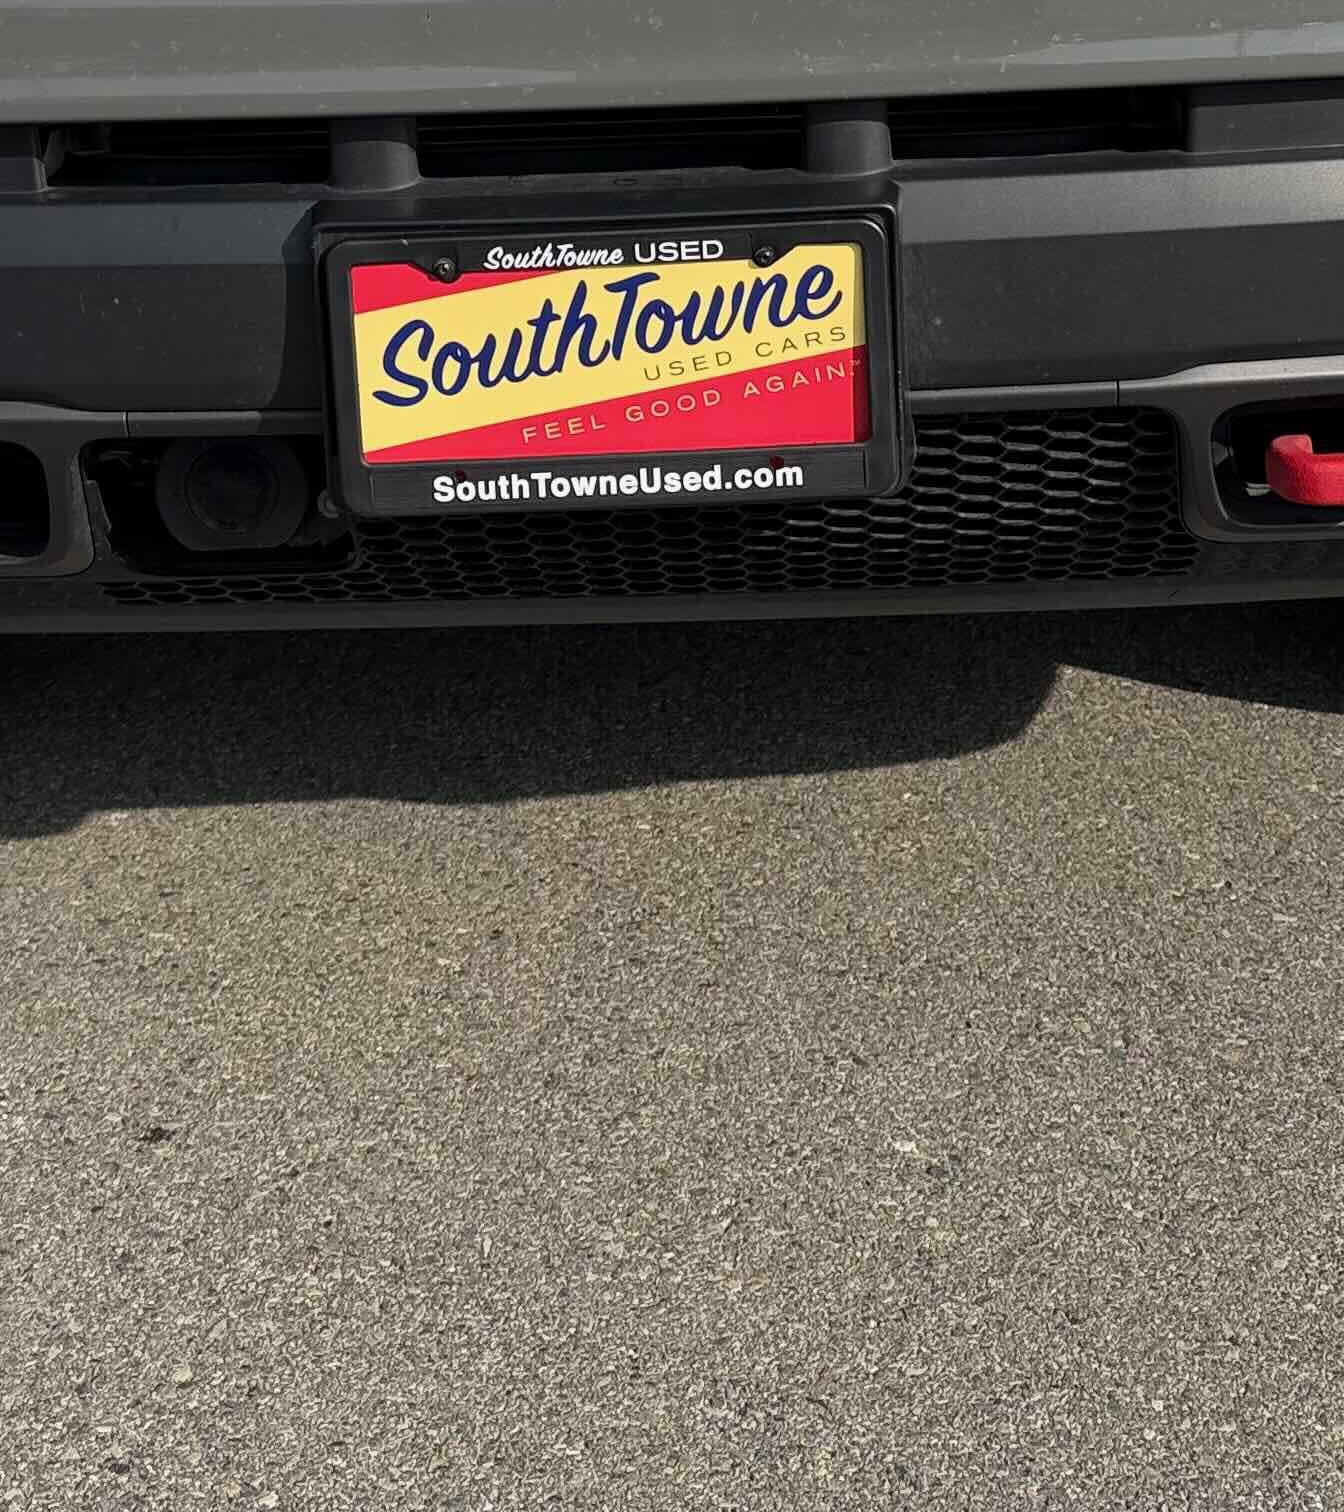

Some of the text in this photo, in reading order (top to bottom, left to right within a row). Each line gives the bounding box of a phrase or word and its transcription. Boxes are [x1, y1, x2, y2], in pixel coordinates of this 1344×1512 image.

[484, 240, 724, 270] SouthTowne USED
[372, 264, 842, 407] SouthTowne
[643, 326, 847, 382] USED CARS
[522, 415, 607, 444] FEEL
[625, 388, 721, 424] GOOD
[433, 464, 803, 503] SouthTowneUsed.com
